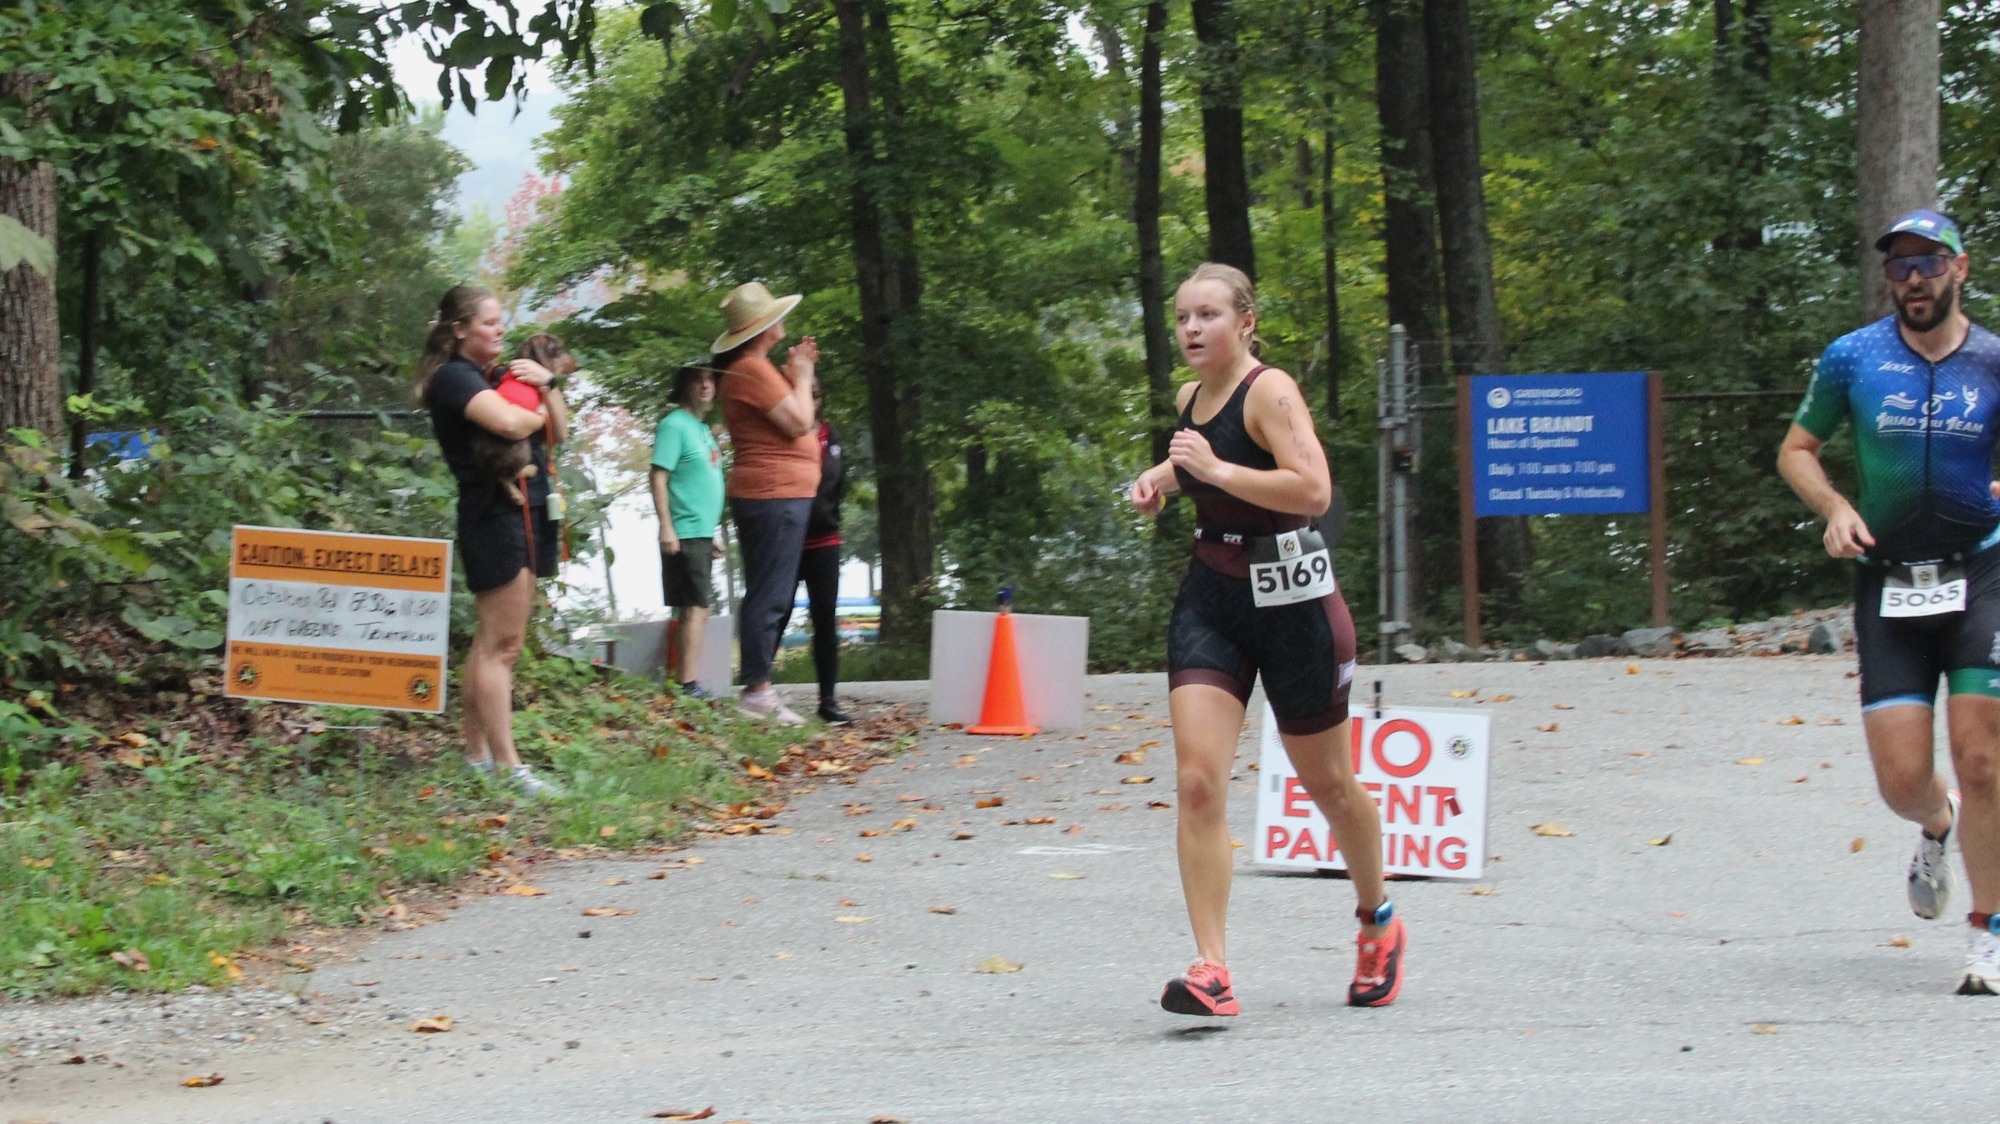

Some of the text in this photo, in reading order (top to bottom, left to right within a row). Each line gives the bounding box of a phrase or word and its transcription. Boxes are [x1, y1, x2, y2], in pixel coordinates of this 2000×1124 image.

[1487, 415, 1594, 435] LAKE BRANDT
[1875, 411, 1984, 433] TRIAD TRI TEAM
[1530, 436, 1579, 451] Operation
[314, 548, 373, 572] EXPECT
[378, 552, 442, 576] DELAYS
[1256, 556, 1327, 594] 5169
[1886, 584, 1960, 607] 5065
[1283, 777, 1457, 827] ENT
